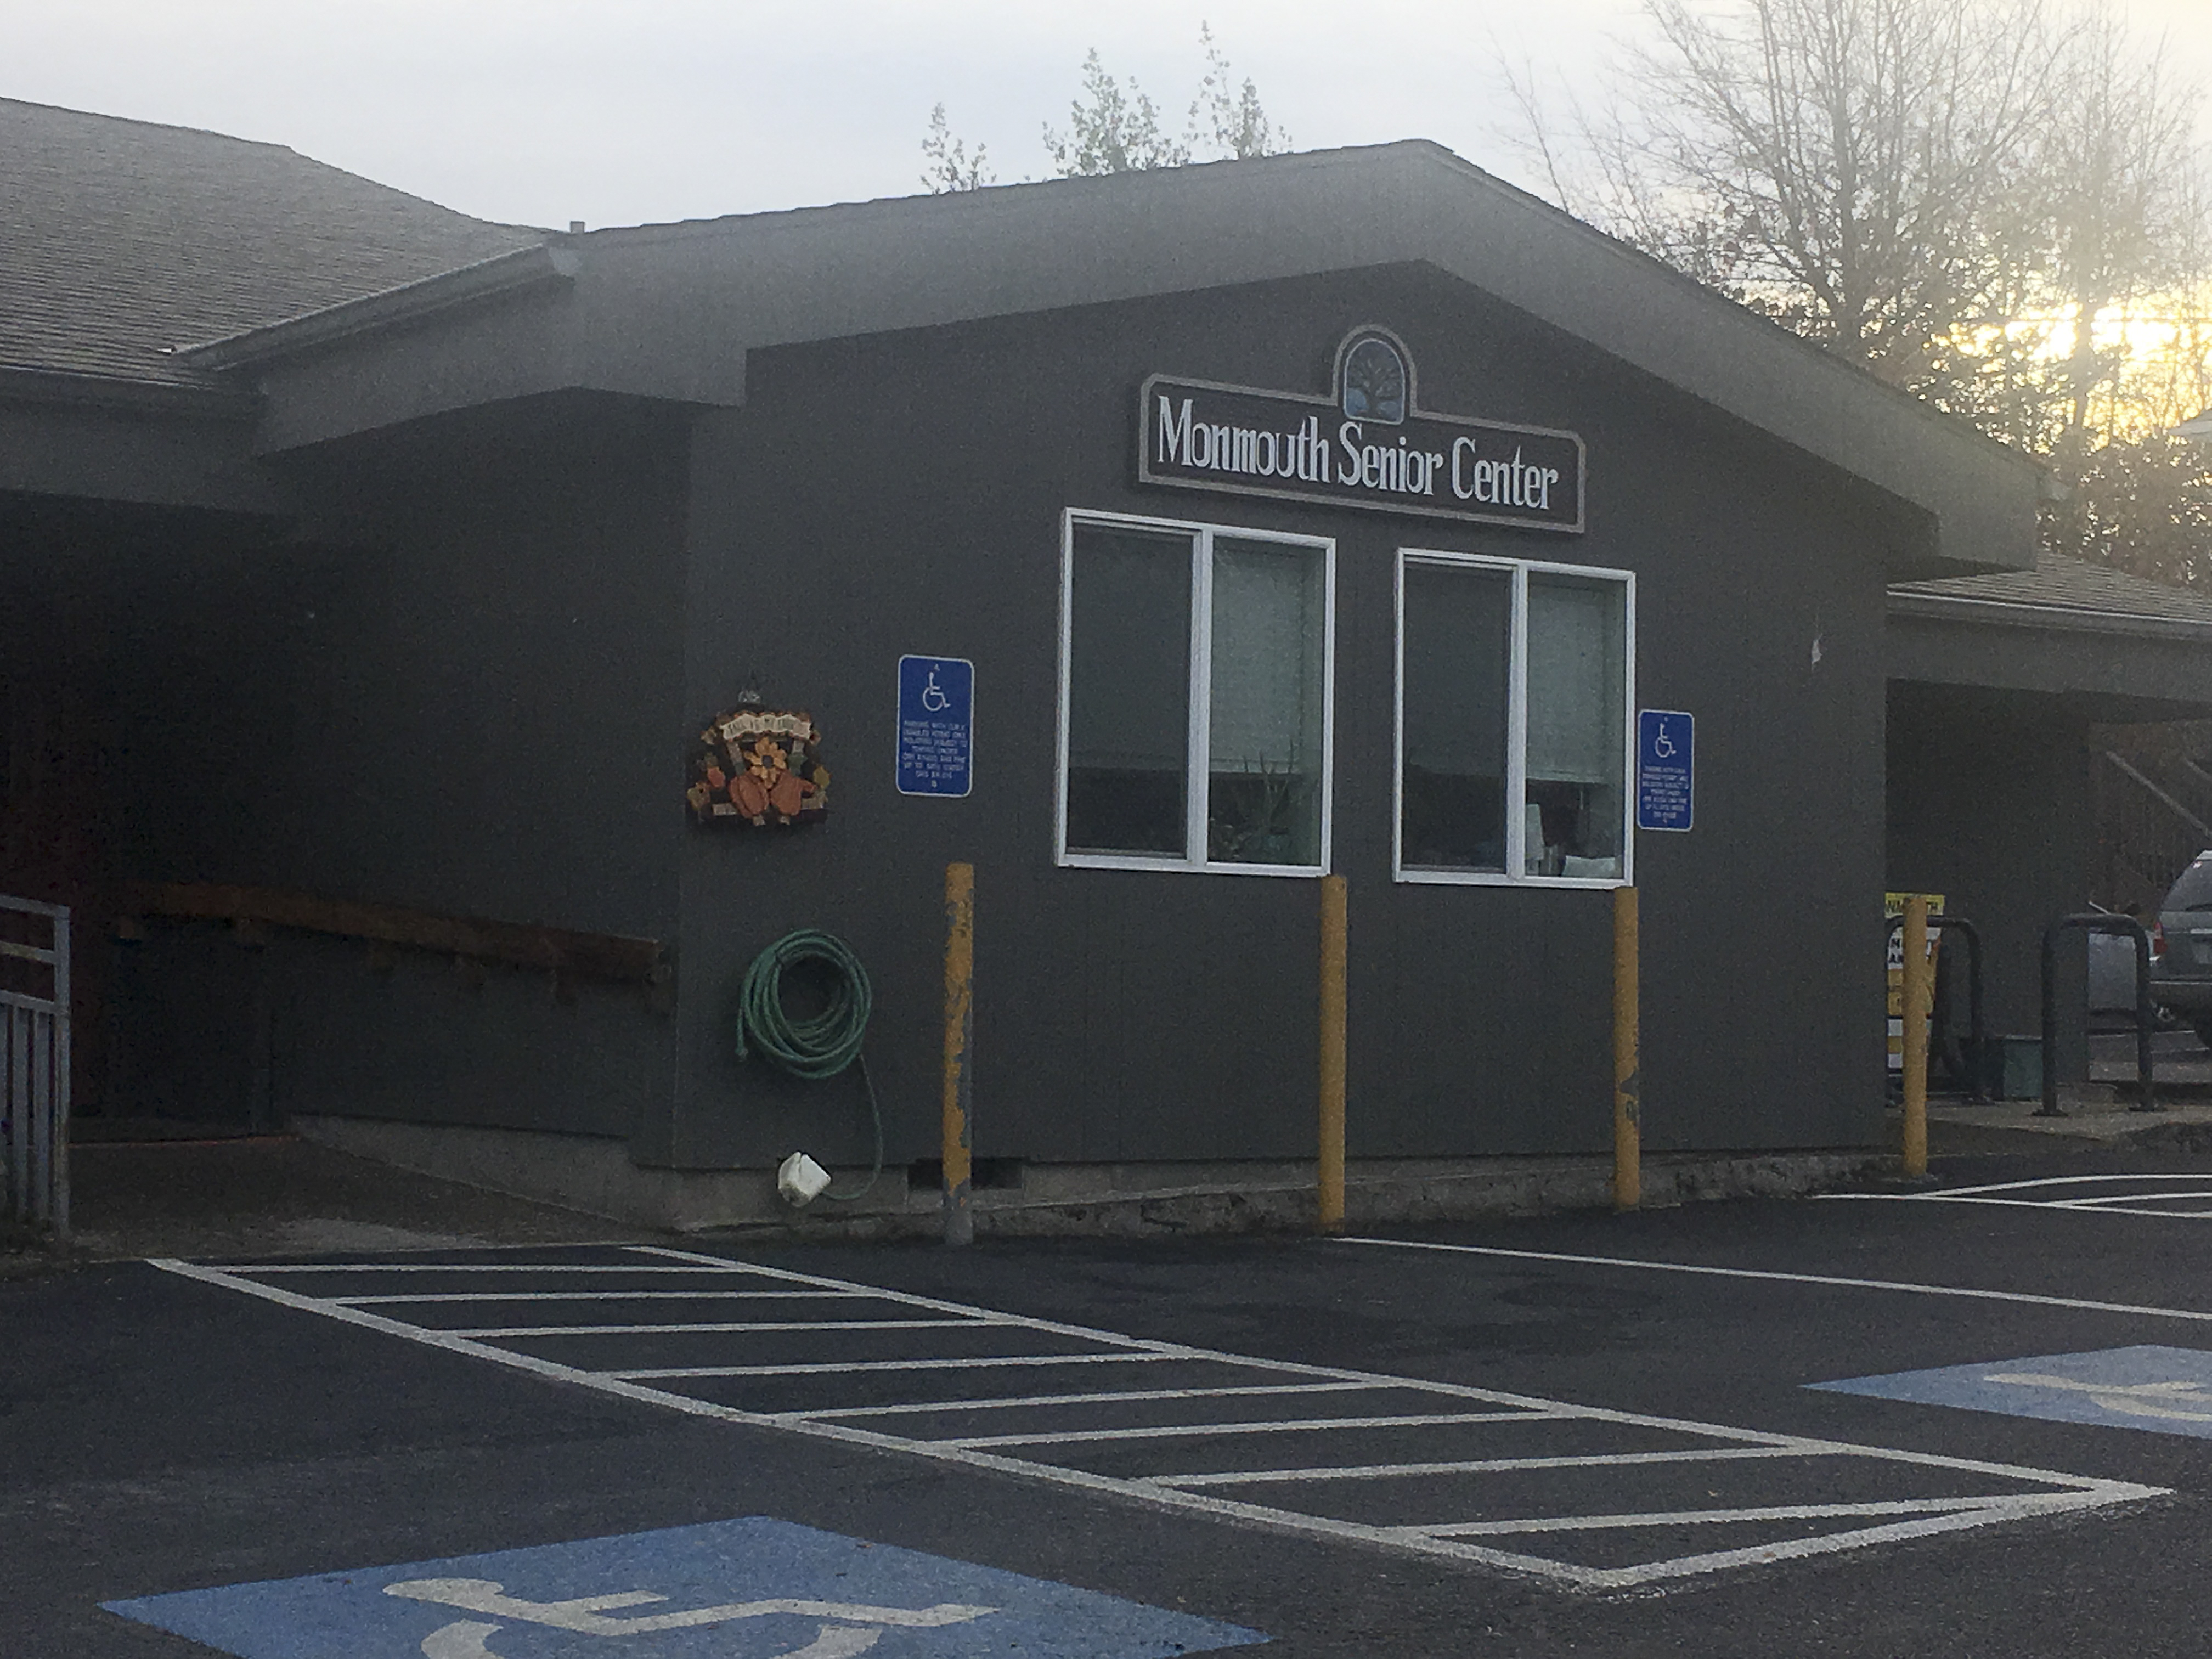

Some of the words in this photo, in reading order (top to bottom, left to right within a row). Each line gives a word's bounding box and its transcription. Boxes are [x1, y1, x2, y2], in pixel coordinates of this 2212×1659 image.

[1158, 395, 1331, 483] Monmouth
[1337, 420, 1444, 496] Senior
[1452, 436, 1559, 510] Center
